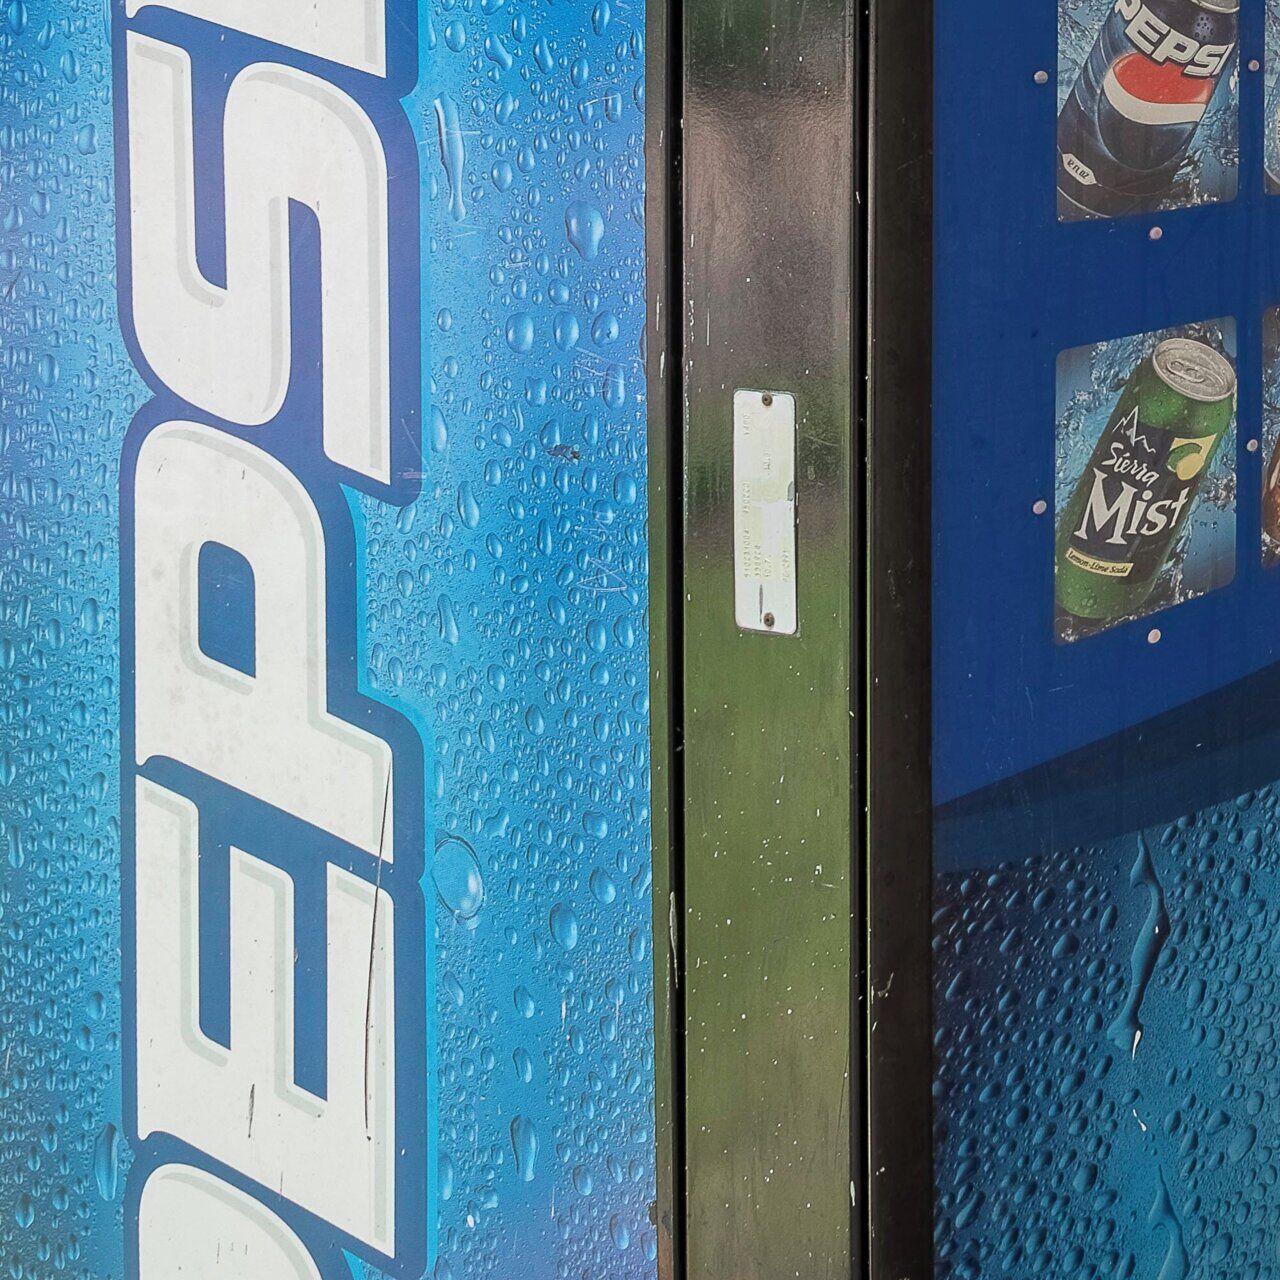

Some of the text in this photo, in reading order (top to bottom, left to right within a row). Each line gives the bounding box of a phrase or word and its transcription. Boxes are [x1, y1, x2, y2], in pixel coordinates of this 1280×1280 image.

[1101, 441, 1162, 488] Sierra
[1073, 467, 1190, 545] Mist
[1109, 565, 1128, 574] Soda
